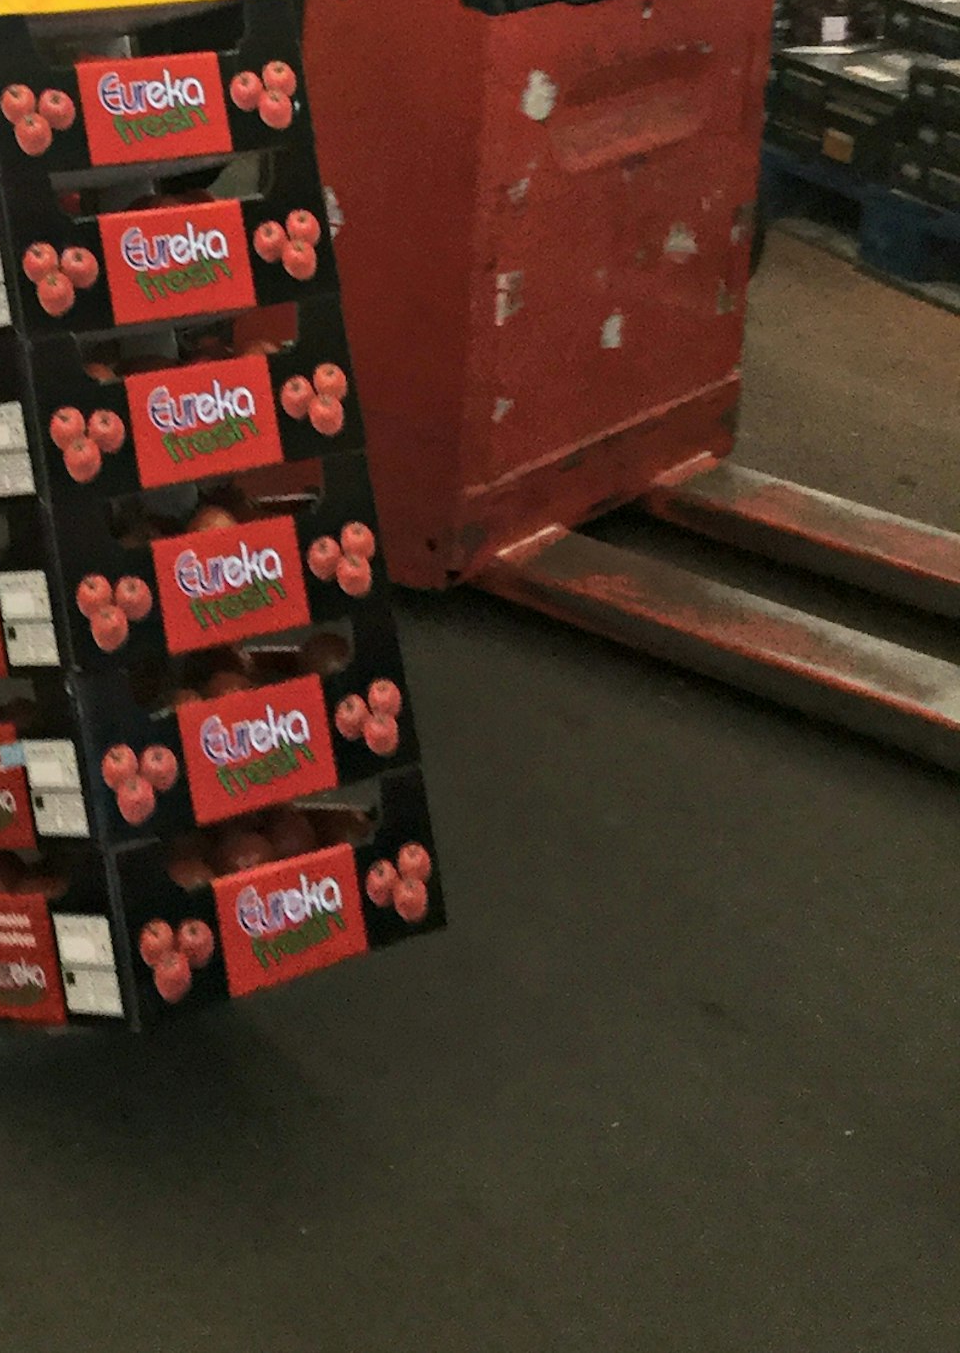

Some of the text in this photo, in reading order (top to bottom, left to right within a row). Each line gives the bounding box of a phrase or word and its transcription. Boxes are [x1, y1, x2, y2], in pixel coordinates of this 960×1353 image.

[97, 68, 206, 115] Eureka
[112, 105, 208, 145] fresh
[121, 221, 229, 271] Eureka
[135, 257, 234, 302] fresh
[147, 379, 256, 433] Eureka
[161, 414, 260, 463] fresh
[174, 540, 283, 597] Eureka
[199, 703, 311, 767] Eureka
[235, 873, 343, 938] Eureka
